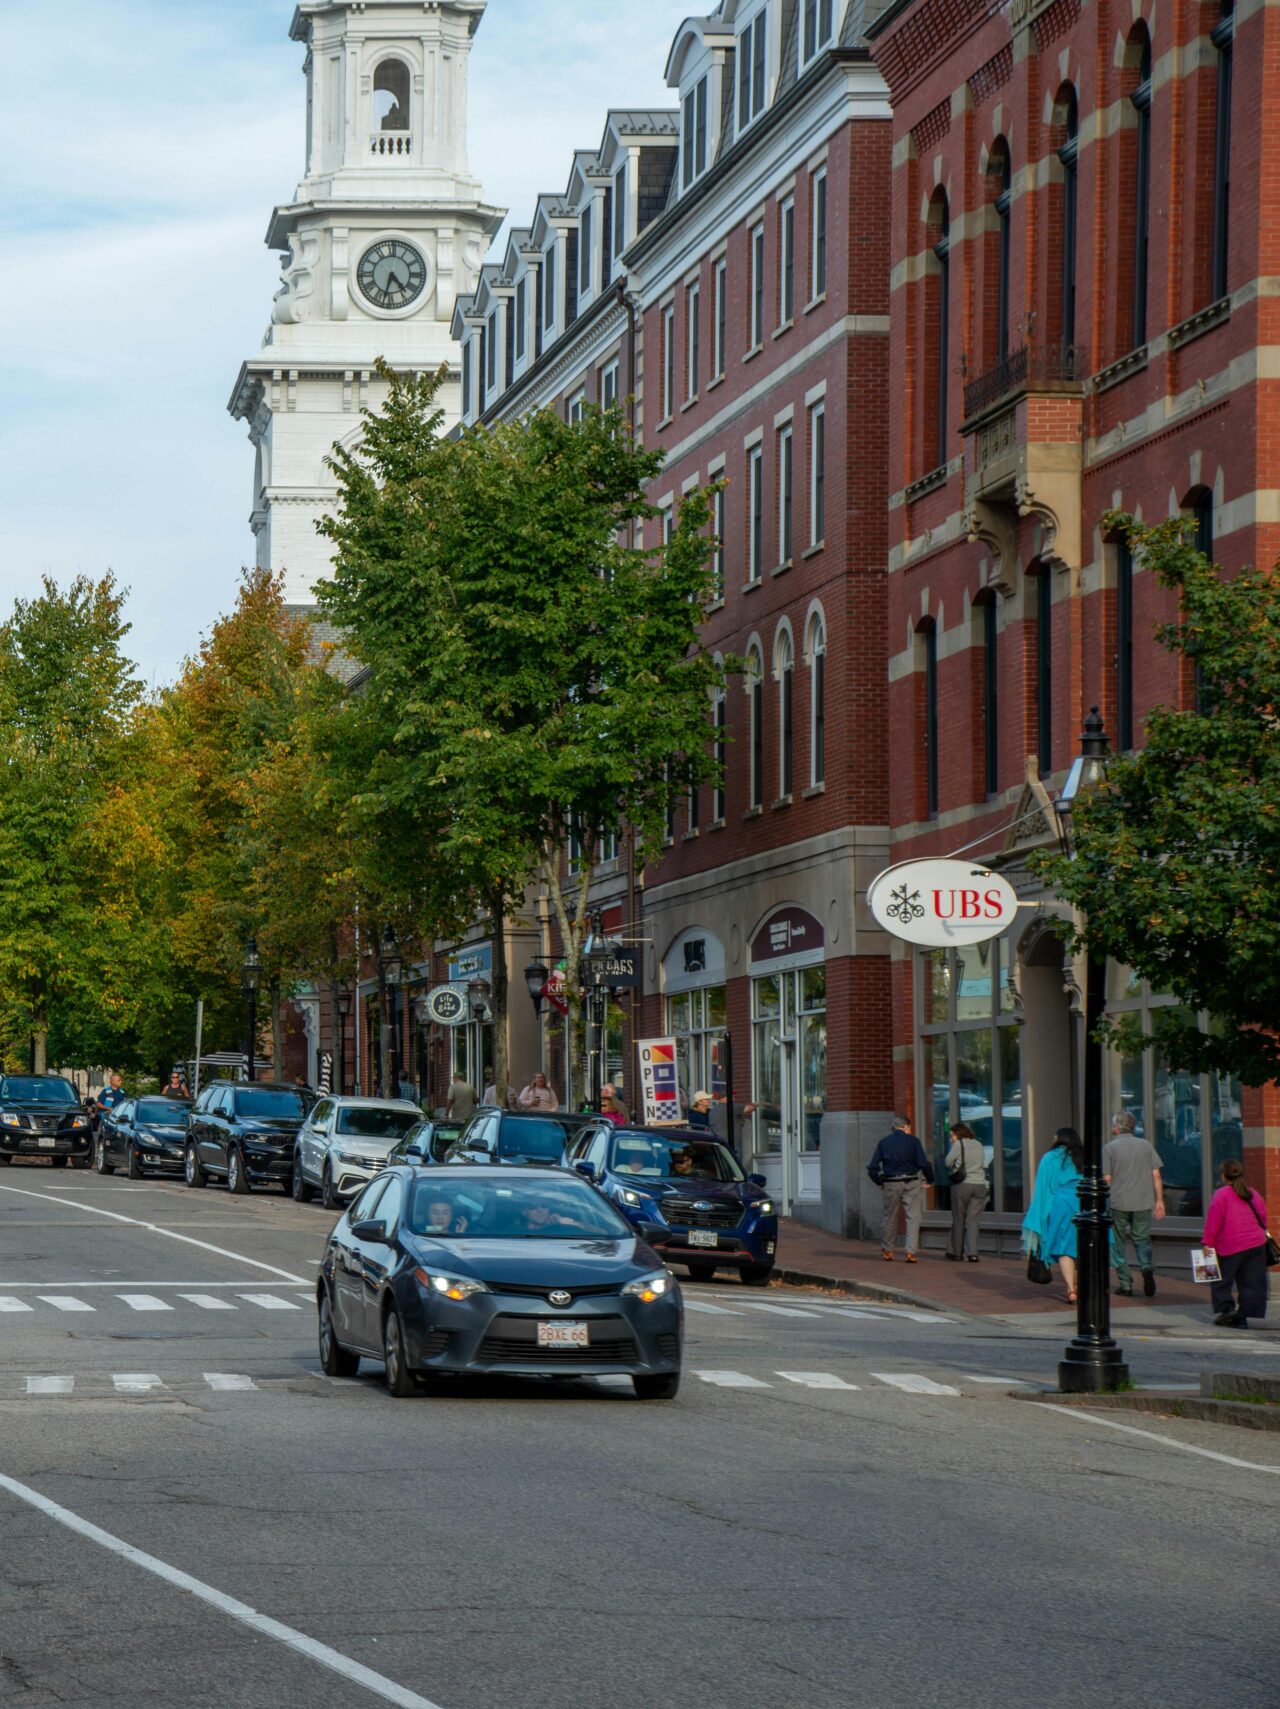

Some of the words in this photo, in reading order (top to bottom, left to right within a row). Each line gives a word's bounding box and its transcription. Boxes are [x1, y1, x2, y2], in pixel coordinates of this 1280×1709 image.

[931, 889, 1003, 919] UBS
[642, 1049, 656, 1118] OPEN
[540, 1328, 569, 1341] 2BXE
[572, 1328, 586, 1341] 66
